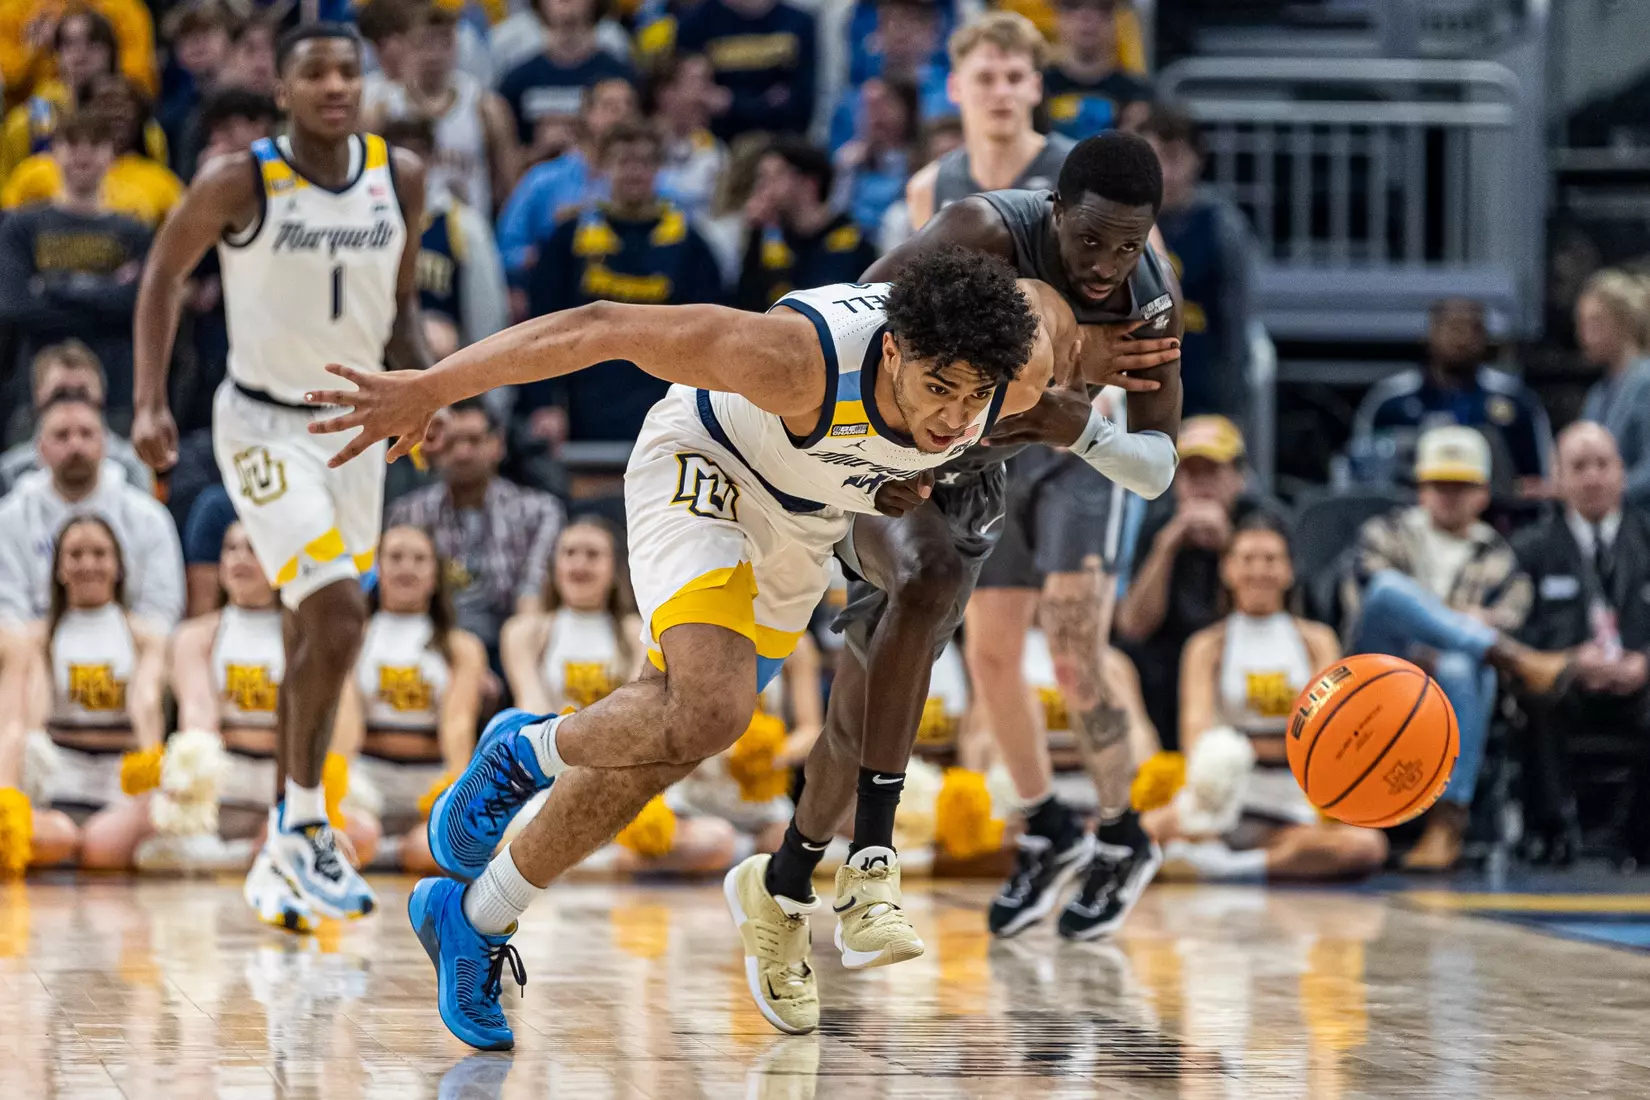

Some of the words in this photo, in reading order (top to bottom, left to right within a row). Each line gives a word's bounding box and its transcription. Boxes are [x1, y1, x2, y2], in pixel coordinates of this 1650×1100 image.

[330, 264, 345, 323] 1
[831, 293, 894, 314] ELL
[669, 451, 741, 523] MU
